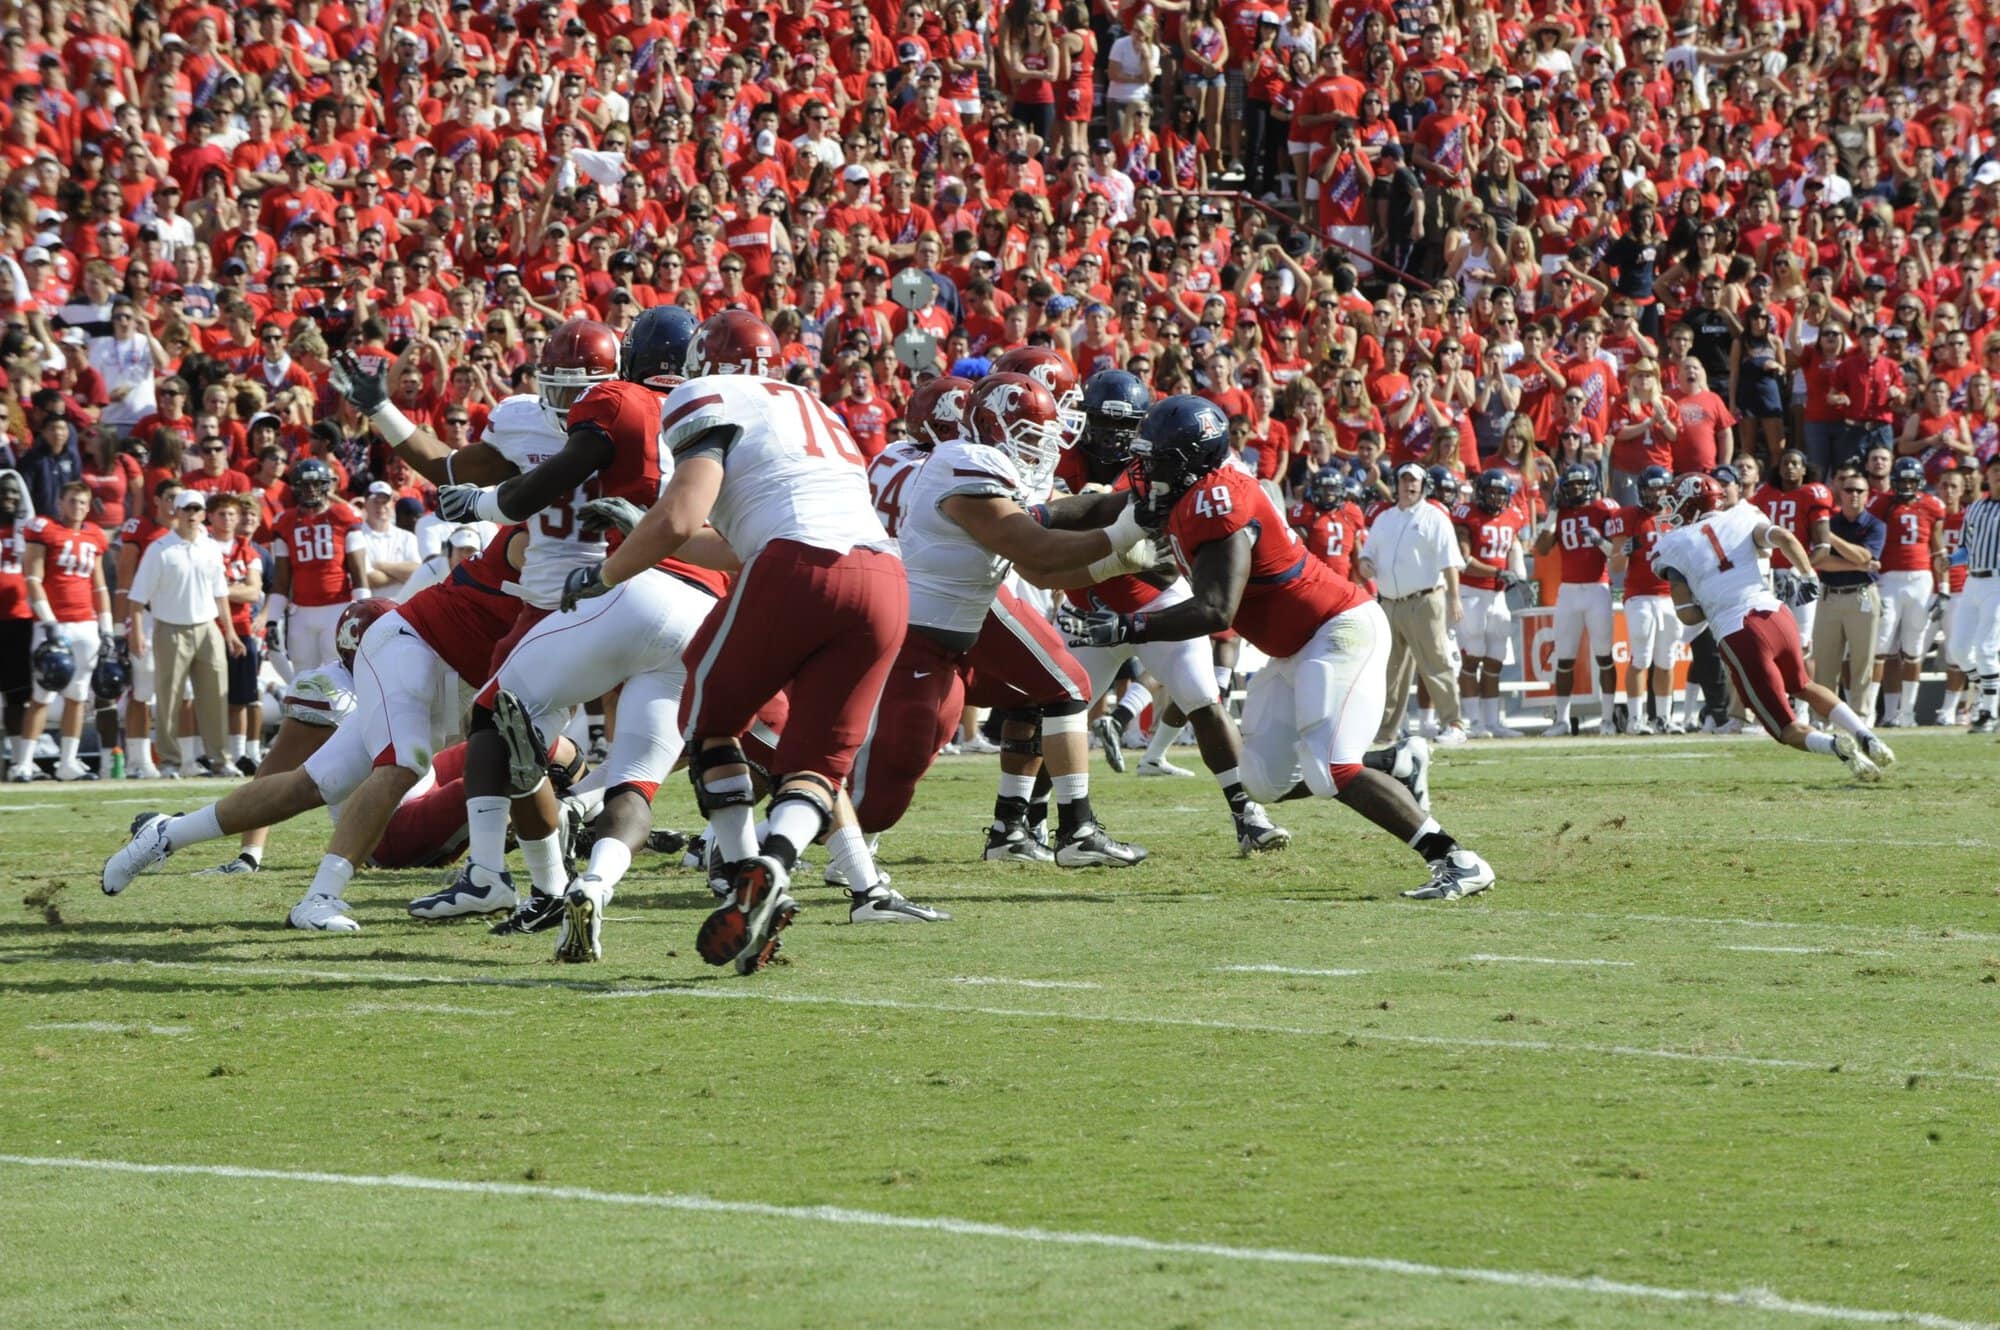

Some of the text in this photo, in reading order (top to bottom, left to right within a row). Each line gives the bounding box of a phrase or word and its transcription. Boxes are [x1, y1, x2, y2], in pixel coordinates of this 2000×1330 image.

[741, 358, 769, 377] 76
[761, 382, 867, 468] 76
[868, 455, 915, 538] 54
[1195, 485, 1233, 519] 49
[1561, 516, 1594, 551] 81
[1768, 500, 1796, 533] 12
[1900, 513, 1918, 545] 3
[294, 523, 334, 562] 58
[1327, 521, 1344, 556] 2
[1480, 525, 1513, 559] 38
[1702, 523, 1735, 573] 1
[56, 540, 97, 578] 40
